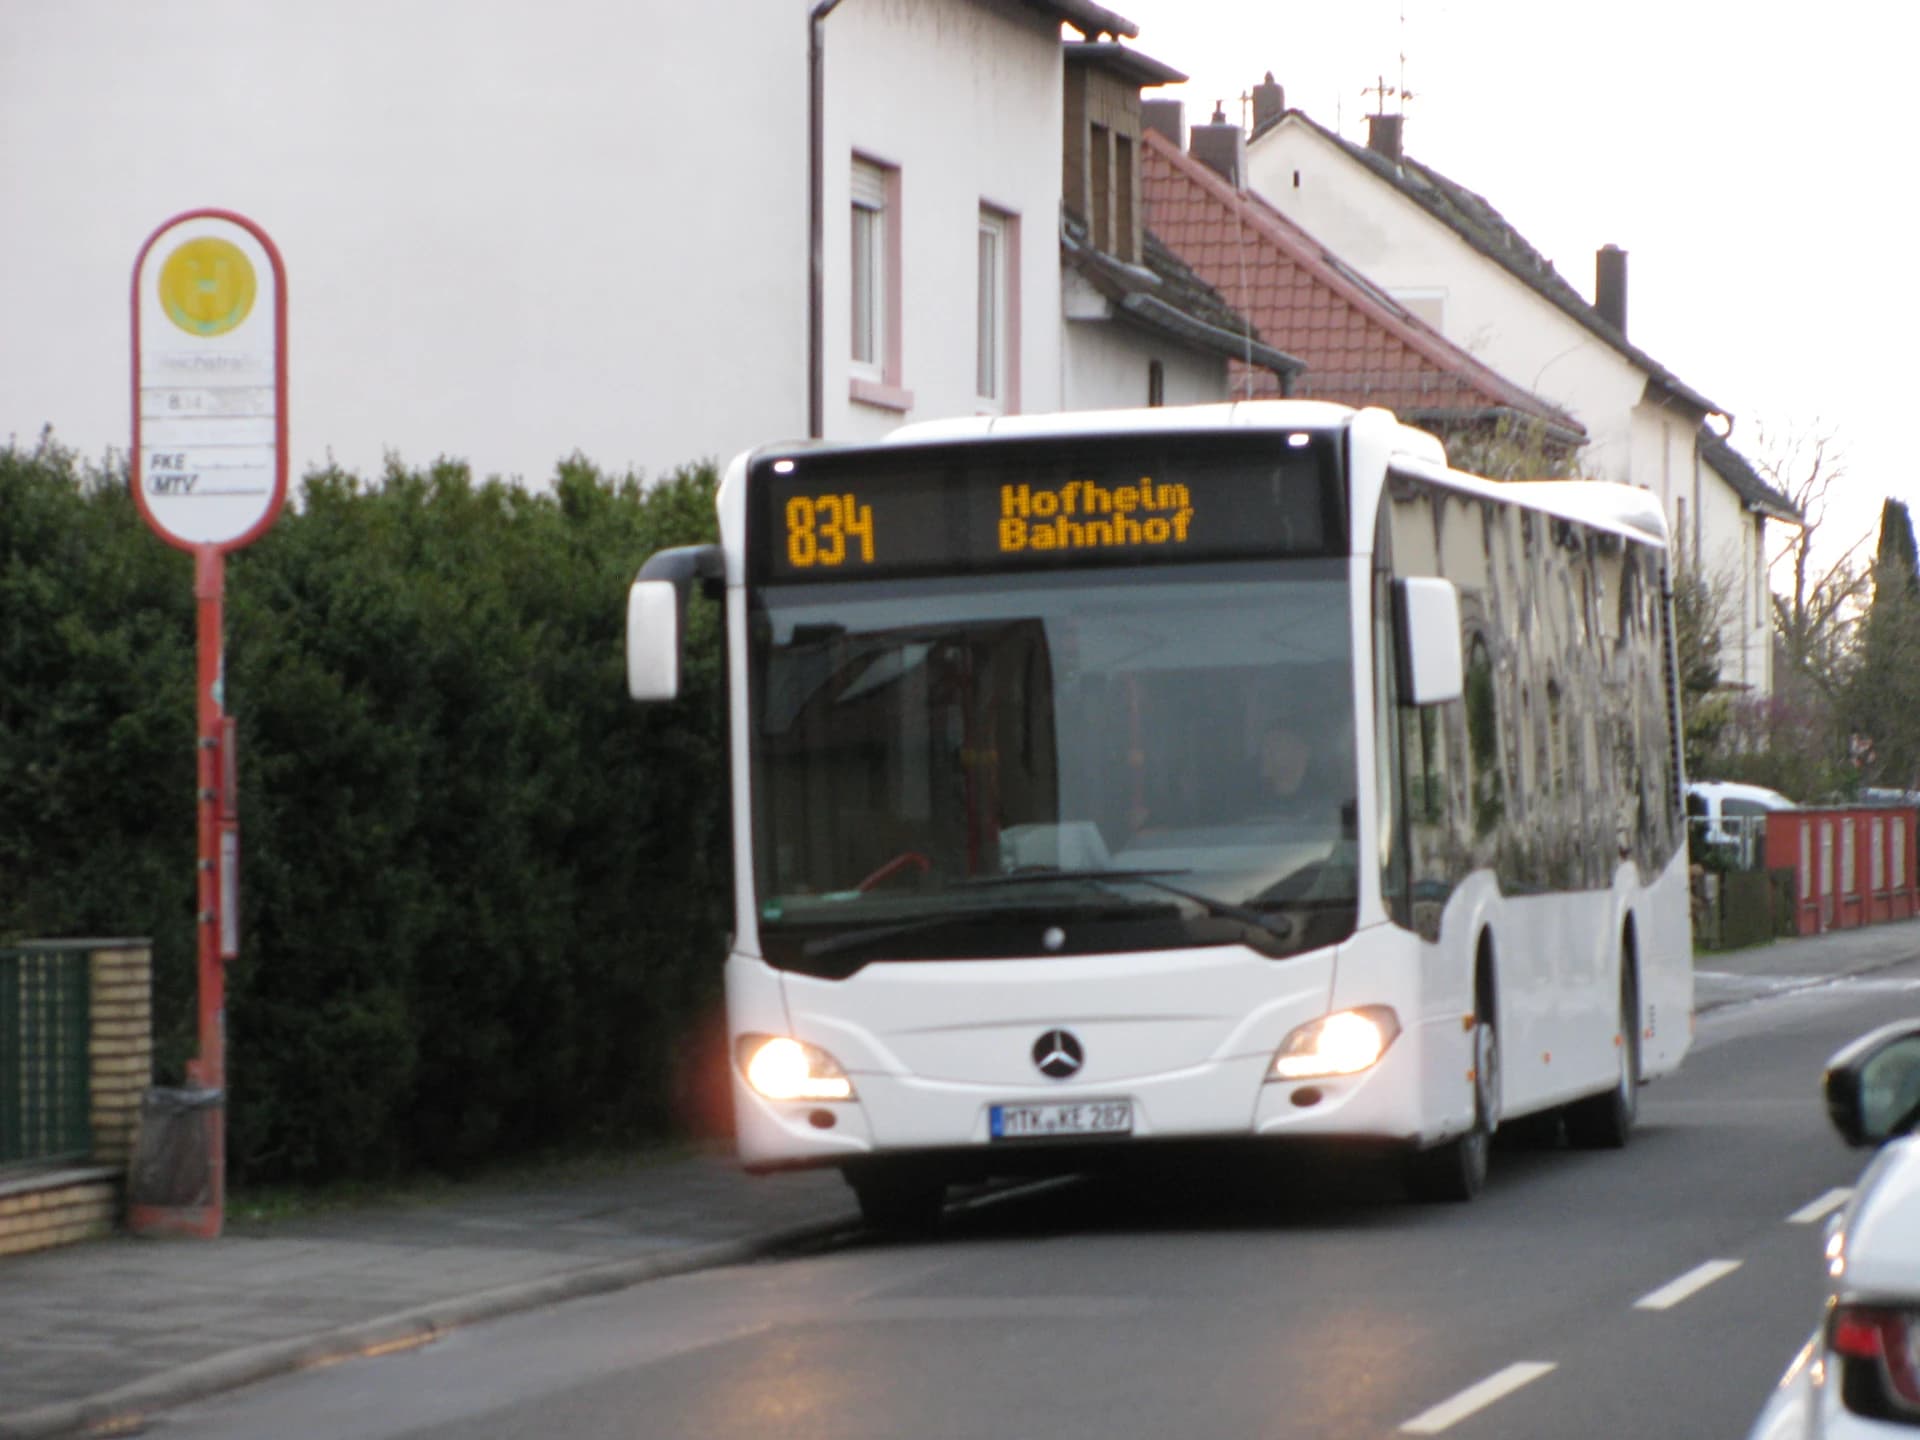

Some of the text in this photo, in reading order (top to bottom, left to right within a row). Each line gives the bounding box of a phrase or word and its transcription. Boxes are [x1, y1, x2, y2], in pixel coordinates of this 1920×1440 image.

[151, 453, 185, 470] FKE
[153, 473, 198, 492] MTV
[1001, 477, 1190, 518] Hofheim
[786, 493, 874, 567] 834
[1000, 507, 1194, 551] Bahnhof
[1004, 1106, 1042, 1130] MTK
[1059, 1105, 1083, 1128] KE
